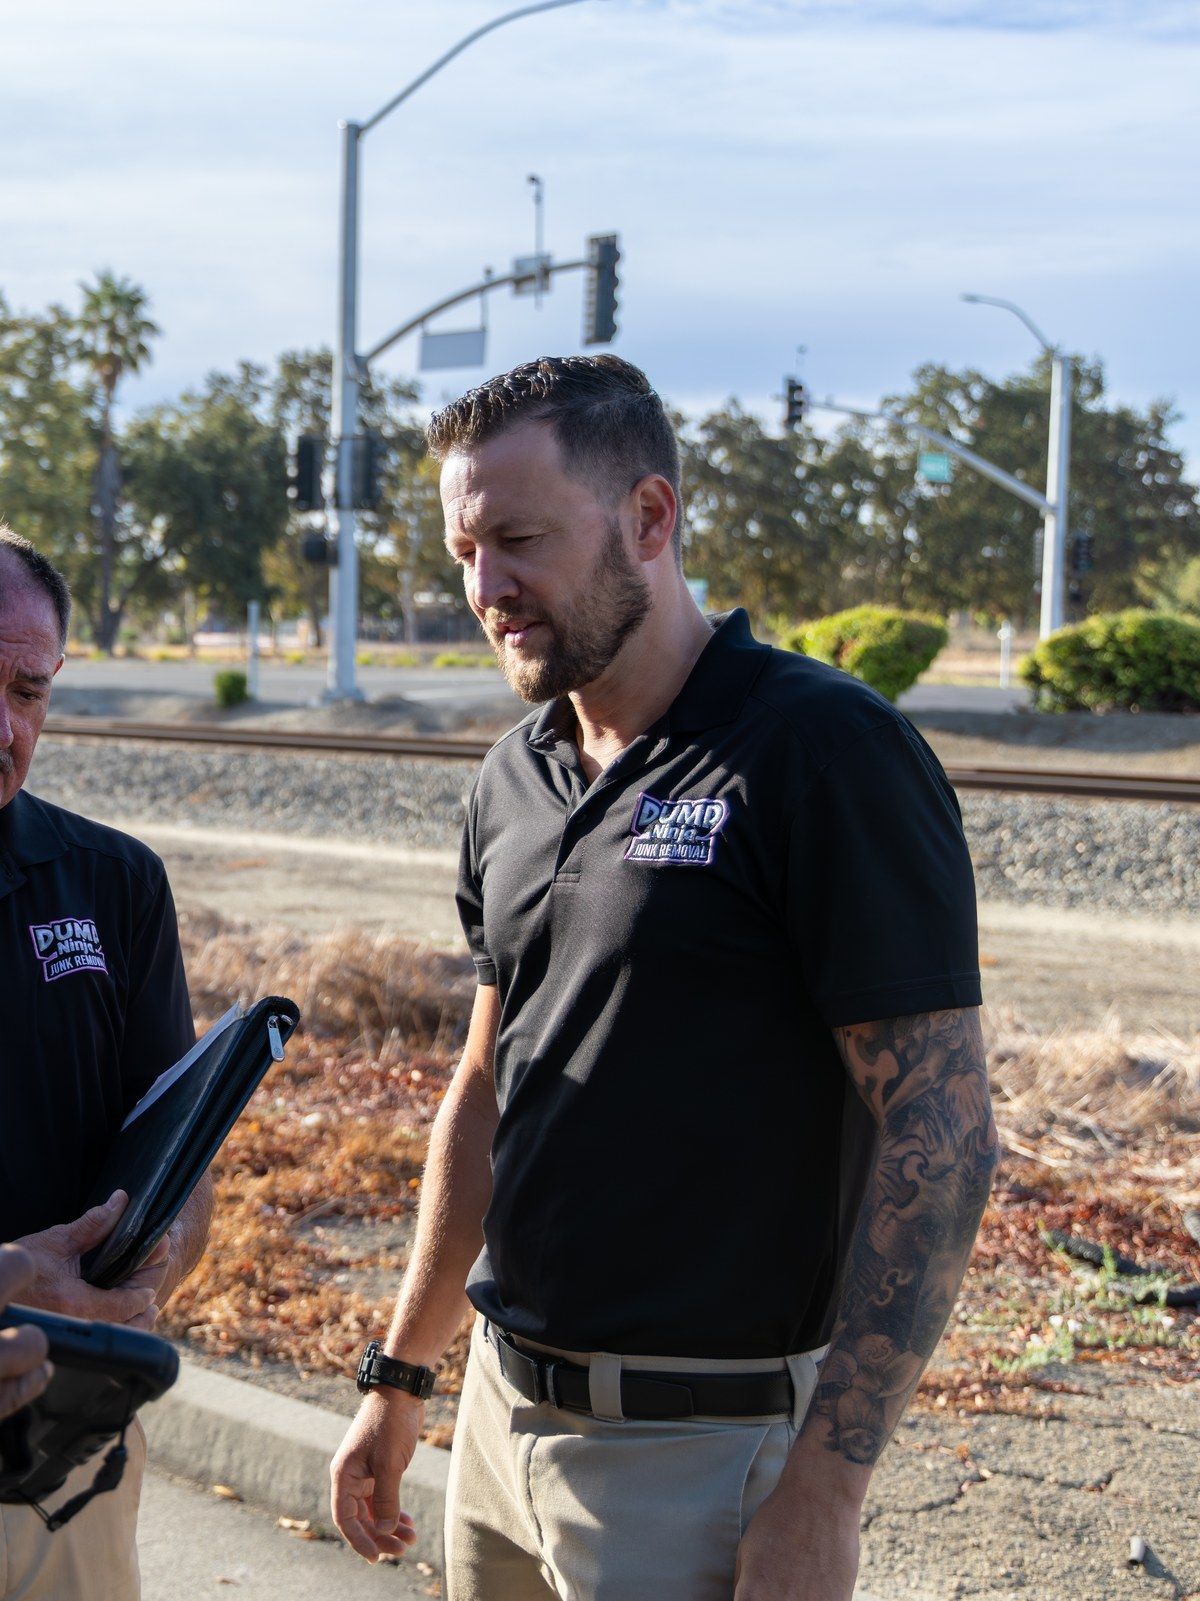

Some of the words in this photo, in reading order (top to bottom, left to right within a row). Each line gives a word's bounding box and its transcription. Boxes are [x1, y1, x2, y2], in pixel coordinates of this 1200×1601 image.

[637, 800, 724, 829] DUMP
[652, 824, 698, 843] Ninja
[633, 843, 659, 856] JUNK
[658, 843, 707, 858] REMOVAL
[56, 938, 94, 955] Ninja
[50, 956, 74, 976] JUNK
